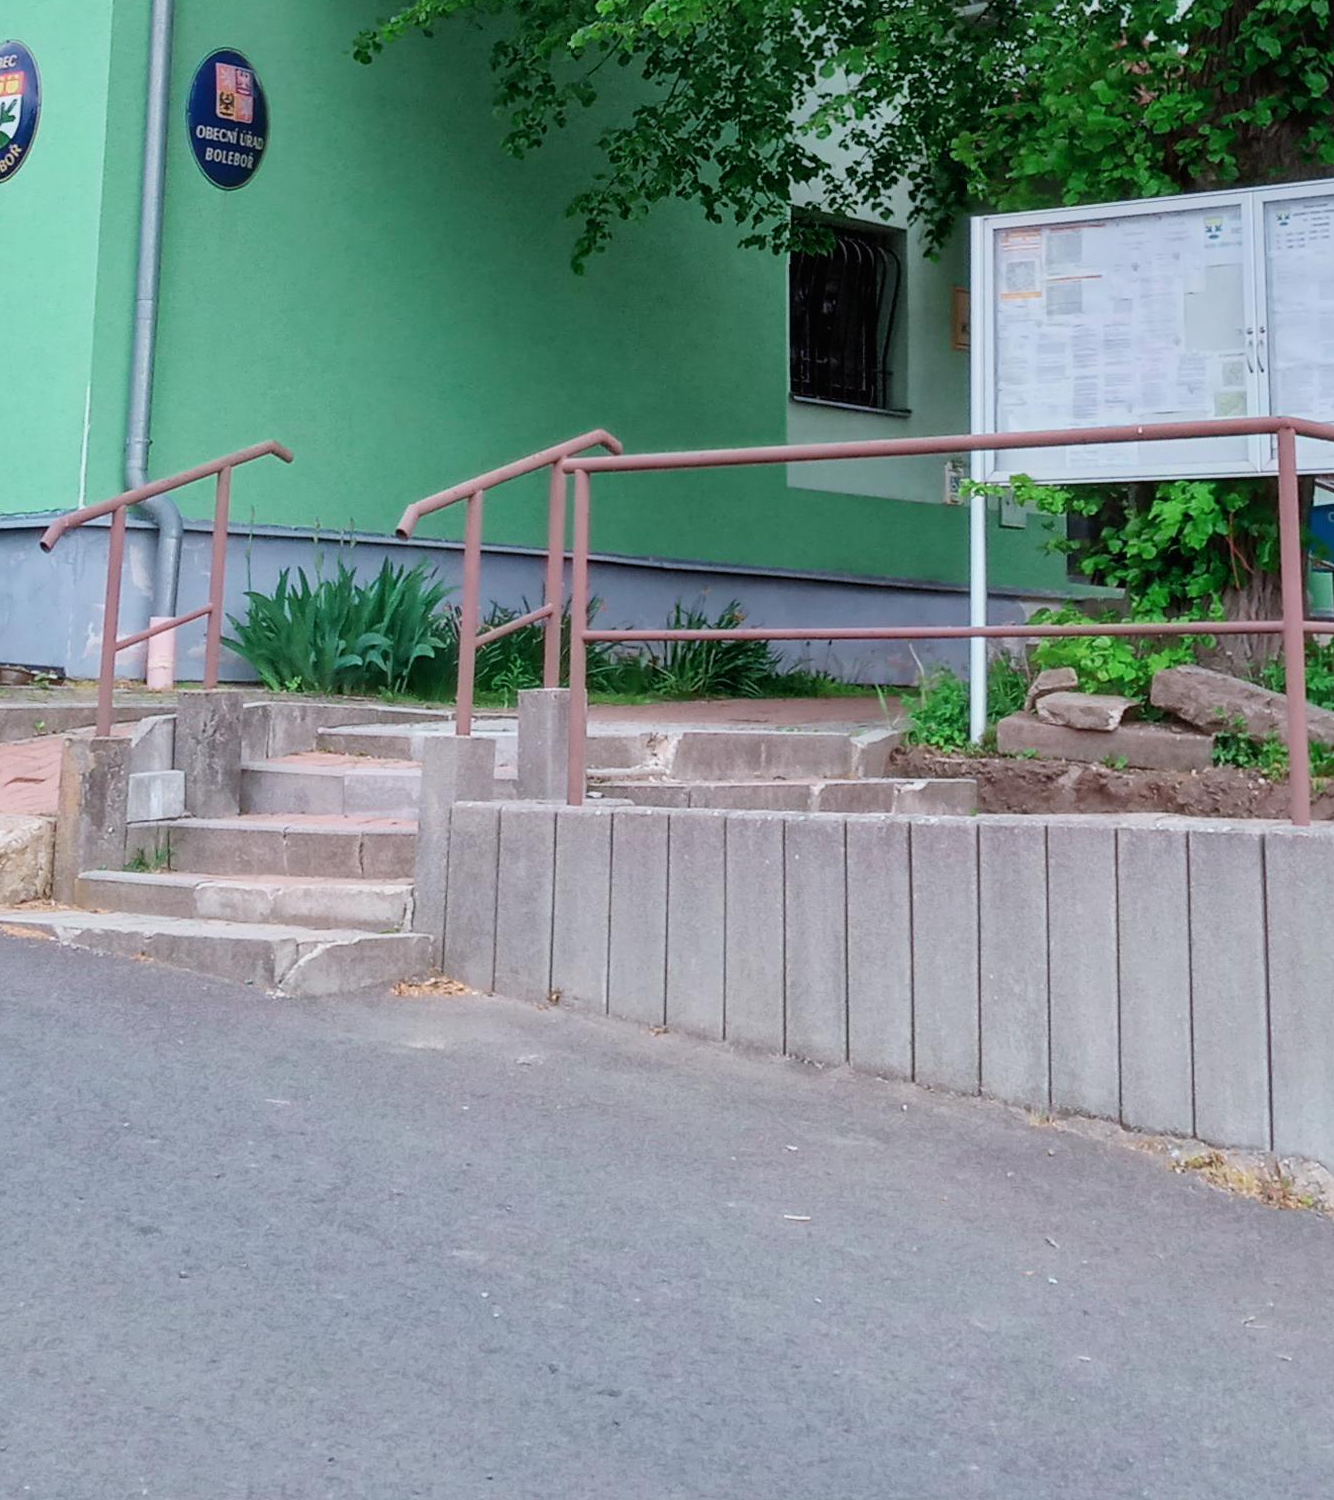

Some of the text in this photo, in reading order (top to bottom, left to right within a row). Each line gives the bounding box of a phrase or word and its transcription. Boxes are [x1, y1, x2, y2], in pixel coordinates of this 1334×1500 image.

[196, 125, 264, 149] OBECNÍ ÚŘAD
[205, 147, 254, 169] BOLEBOŘ
